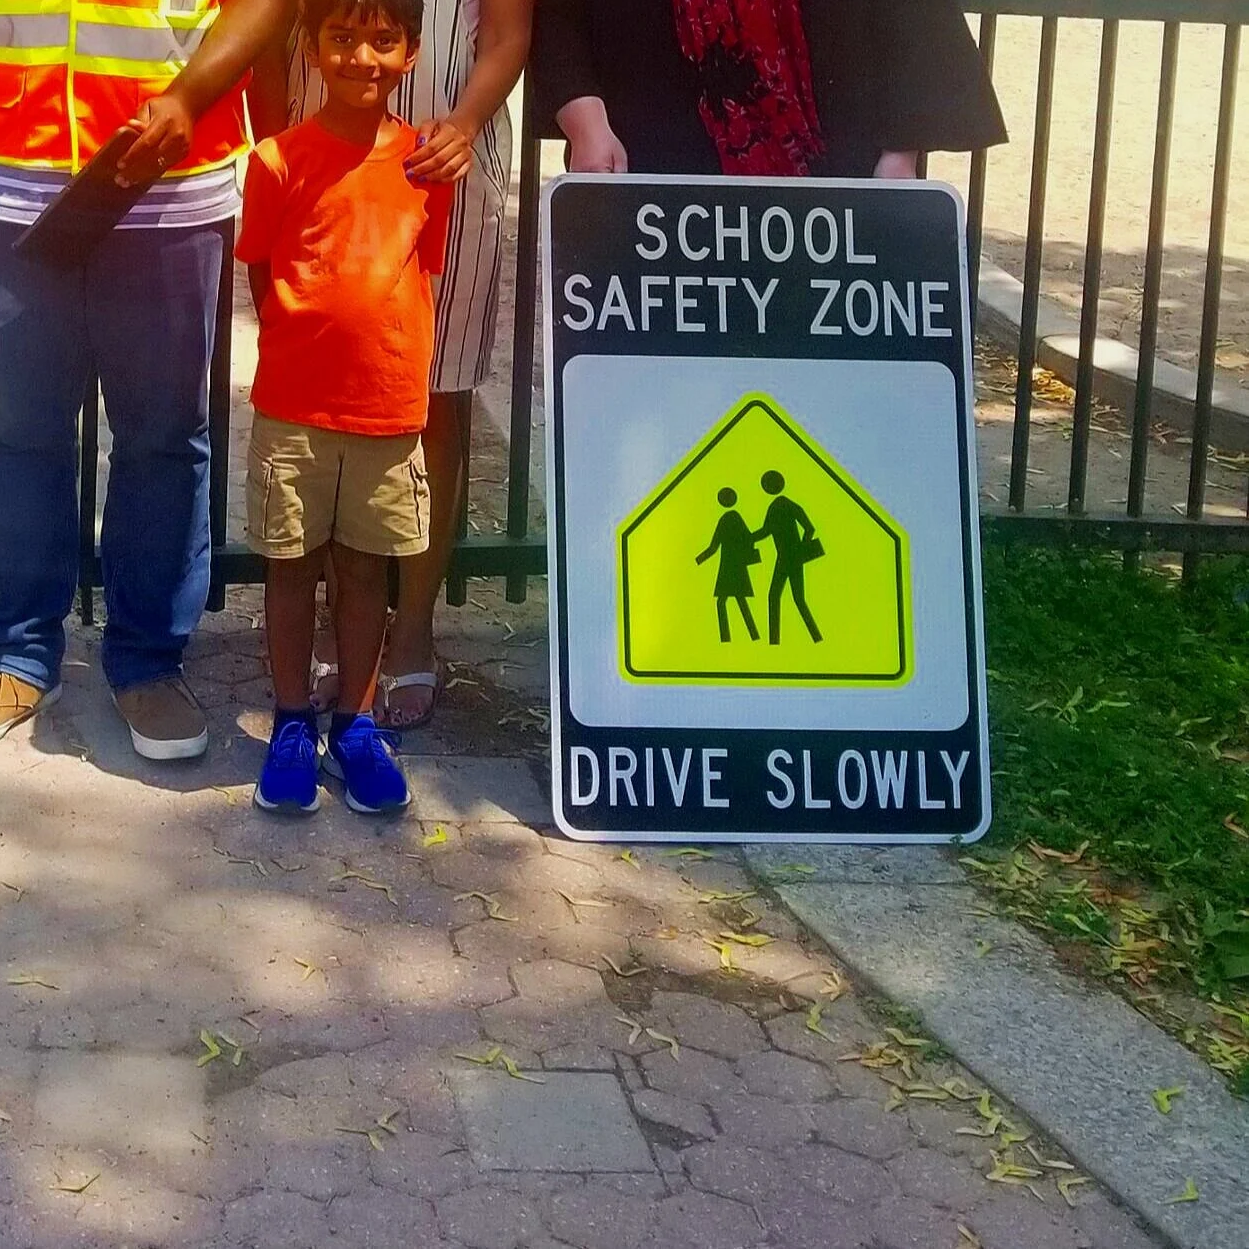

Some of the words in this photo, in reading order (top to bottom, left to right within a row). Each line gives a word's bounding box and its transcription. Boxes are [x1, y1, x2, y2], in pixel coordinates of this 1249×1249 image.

[635, 203, 877, 265] SCHOOL
[562, 273, 780, 334] SAFETY
[809, 279, 953, 338] ZONE
[570, 746, 730, 808] DRIVE
[766, 748, 970, 810] SLOWLY
